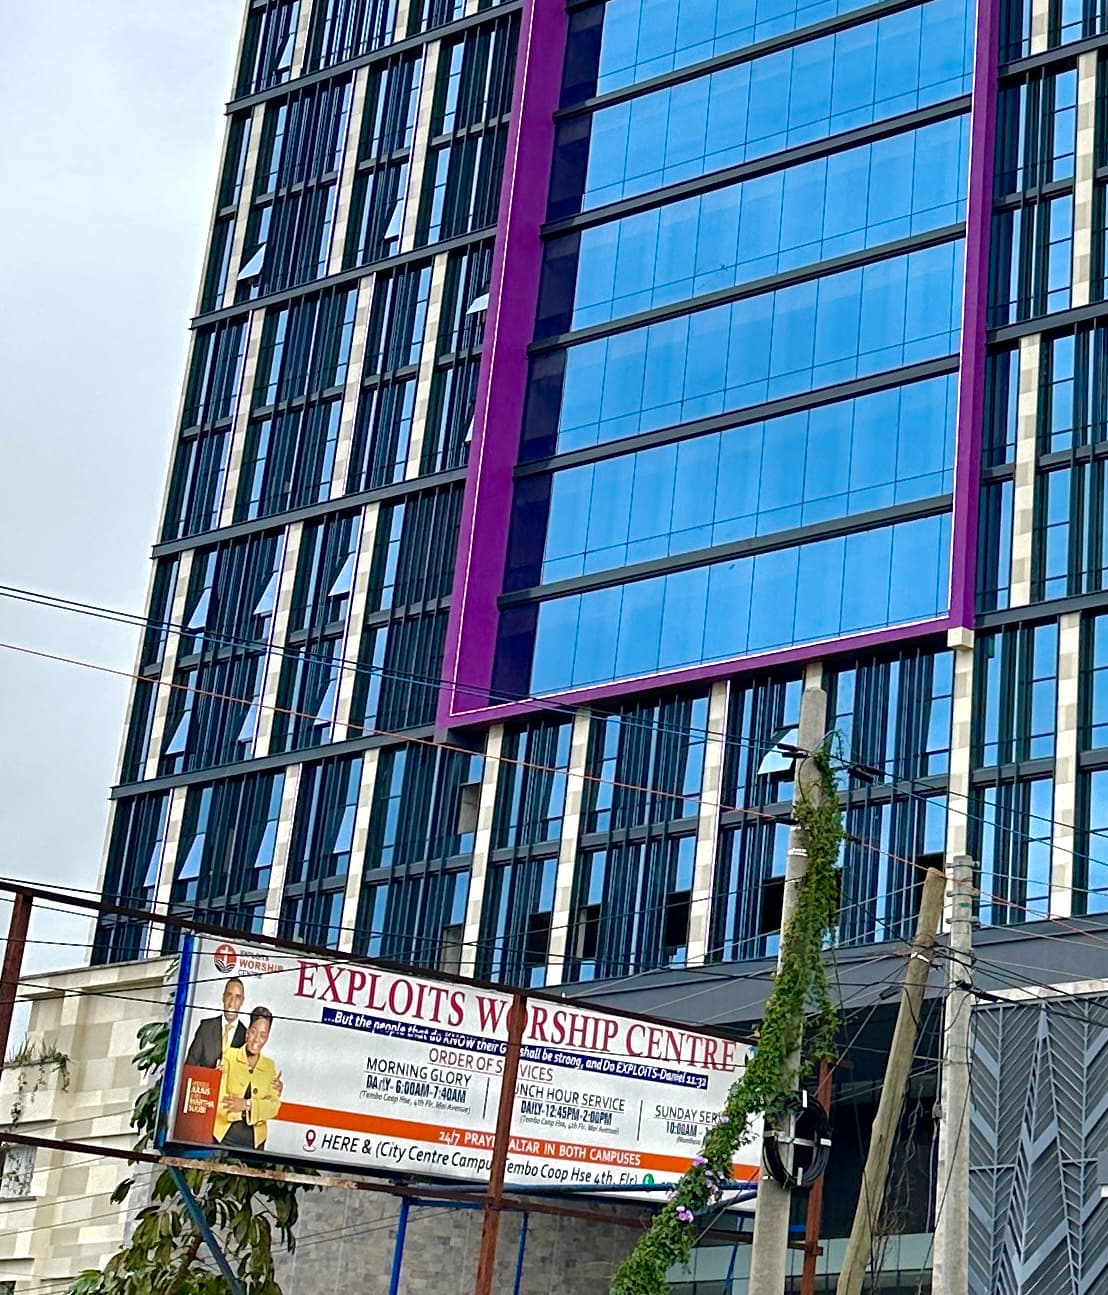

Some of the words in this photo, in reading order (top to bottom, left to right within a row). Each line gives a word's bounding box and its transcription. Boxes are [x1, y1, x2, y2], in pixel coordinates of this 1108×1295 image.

[239, 959, 284, 973] WORSHIP
[294, 960, 465, 1027] EXPLOITS
[626, 1024, 736, 1073] CENTRE
[355, 1015, 372, 1029] the
[442, 1032, 476, 1050] KNOW
[476, 1038, 499, 1053] their
[520, 1046, 541, 1060] shall
[542, 1048, 553, 1062] be
[585, 1057, 602, 1071] and
[366, 1057, 428, 1080] MORNING
[430, 1069, 472, 1087] GLORY
[428, 1048, 474, 1069] ORDER
[476, 1056, 493, 1072] OF
[495, 1059, 553, 1082] SVICES
[546, 1088, 579, 1104] HOUR
[582, 1093, 625, 1111] SERVICE
[656, 1105, 698, 1122] SUNDAY
[321, 1133, 359, 1153] HERE
[361, 1139, 371, 1155] &
[375, 1141, 407, 1164] (City
[408, 1145, 450, 1165] Centre
[451, 1151, 493, 1173] Campu
[505, 1157, 538, 1177] embo
[540, 1164, 569, 1183] Coop
[571, 1167, 592, 1183] Hse
[438, 1130, 460, 1146] 24/7
[464, 1132, 496, 1148] PRAY
[508, 1139, 541, 1154] ALTAR
[543, 1142, 555, 1155] IN
[559, 1144, 587, 1159] BOTH
[589, 1148, 642, 1166] CAMPUSES
